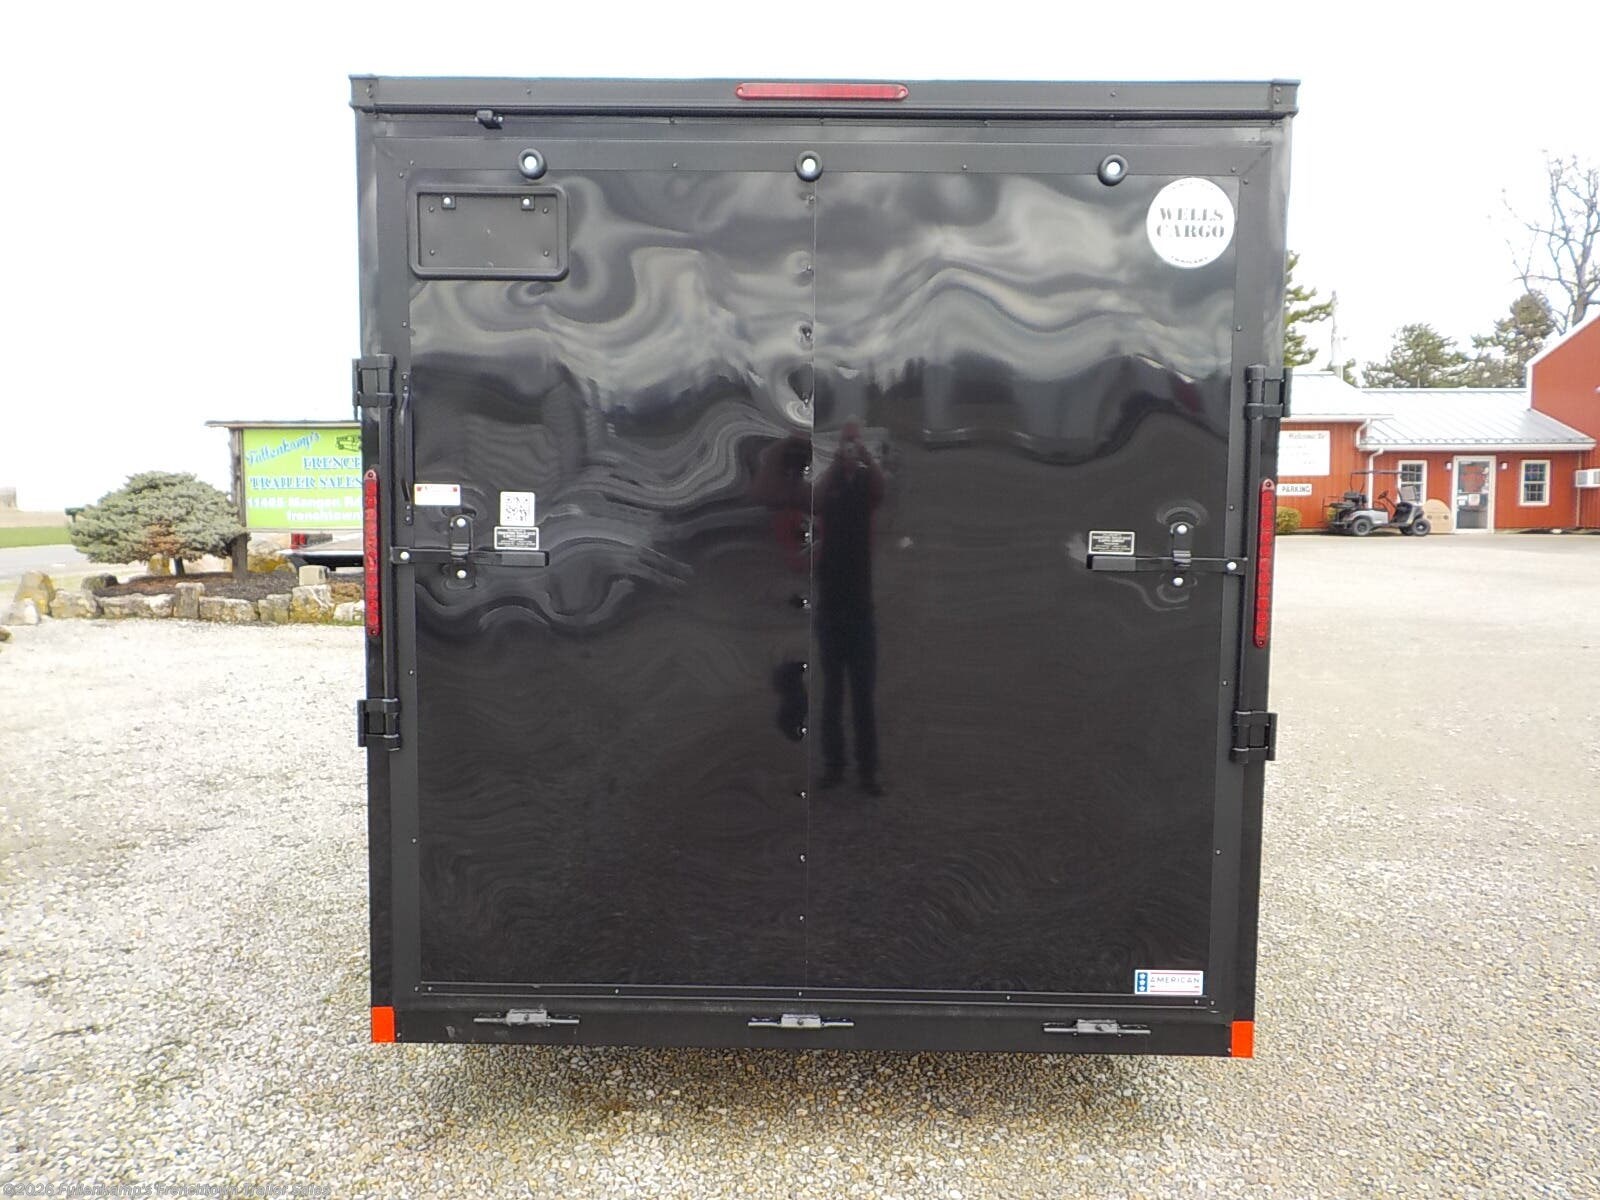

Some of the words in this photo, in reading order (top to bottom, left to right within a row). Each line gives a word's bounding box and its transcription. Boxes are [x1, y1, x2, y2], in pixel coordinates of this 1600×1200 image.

[1158, 207, 1223, 221] WELLS
[1156, 224, 1225, 238] CARGO
[249, 477, 316, 490] TRAILER
[1281, 485, 1311, 493] PARKING
[1150, 976, 1200, 984] AMERICAN
